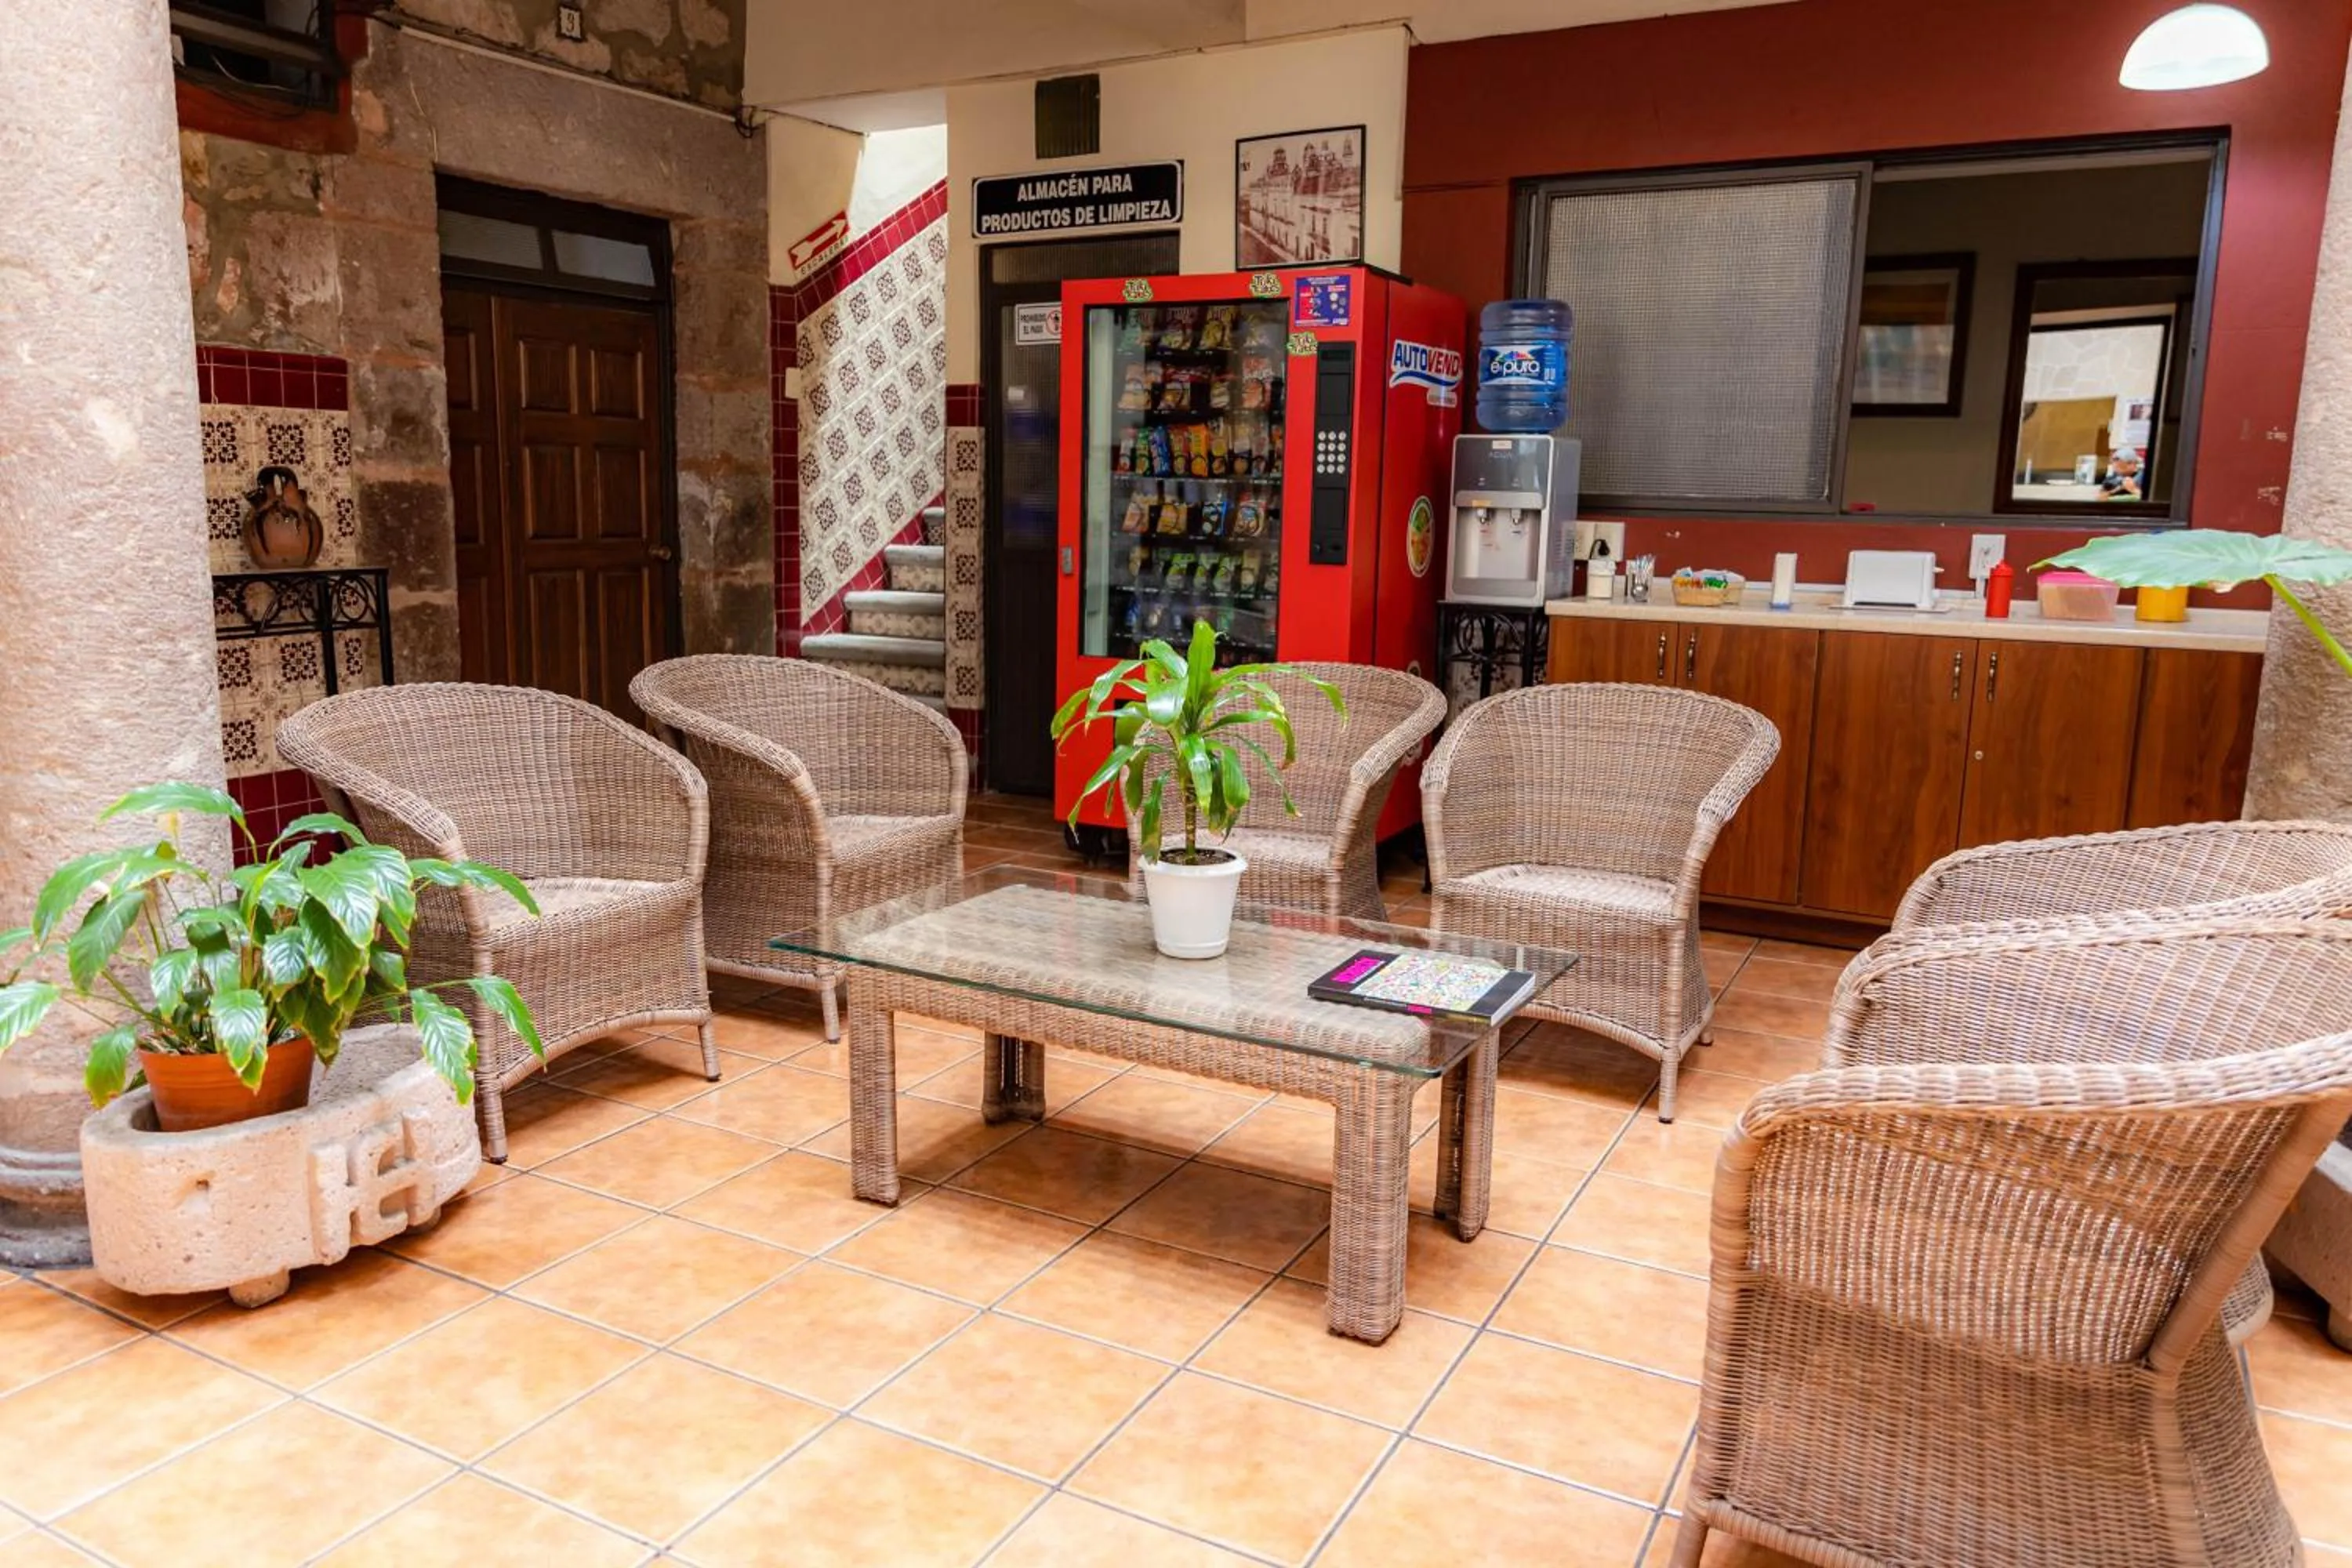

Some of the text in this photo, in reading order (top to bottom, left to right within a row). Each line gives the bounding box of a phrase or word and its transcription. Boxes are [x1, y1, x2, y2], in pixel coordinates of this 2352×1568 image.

[1017, 173, 1133, 201] ALMACÉN PARA
[982, 199, 1171, 233] PRODUCTOS DE LIMPIEZA
[1393, 342, 1459, 377] AUTOVEND
